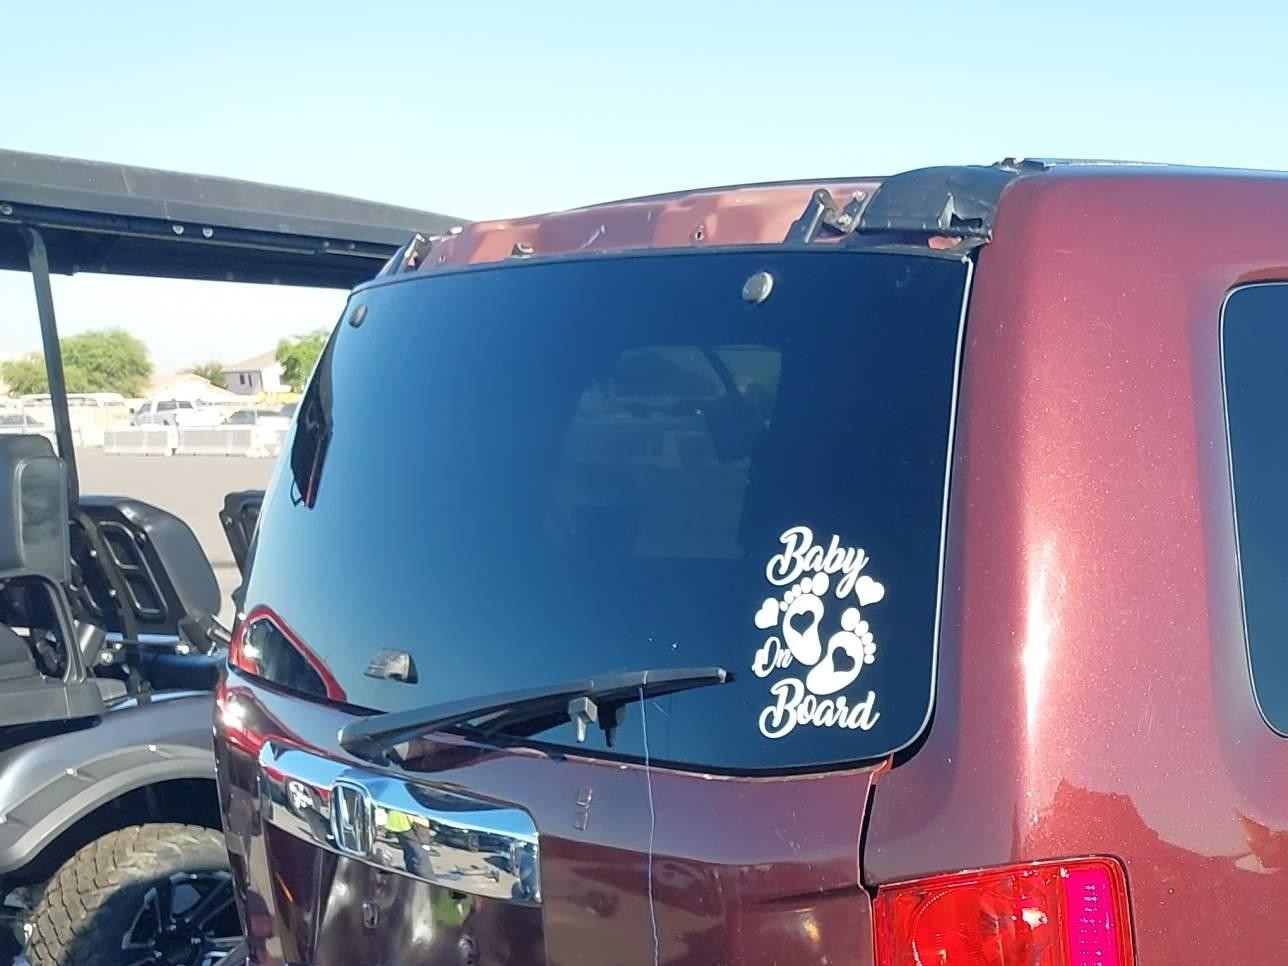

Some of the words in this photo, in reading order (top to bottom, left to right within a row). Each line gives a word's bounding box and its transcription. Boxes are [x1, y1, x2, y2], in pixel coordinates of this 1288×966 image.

[766, 526, 869, 599] Baby
[752, 636, 793, 678] On
[759, 677, 880, 738] Board
